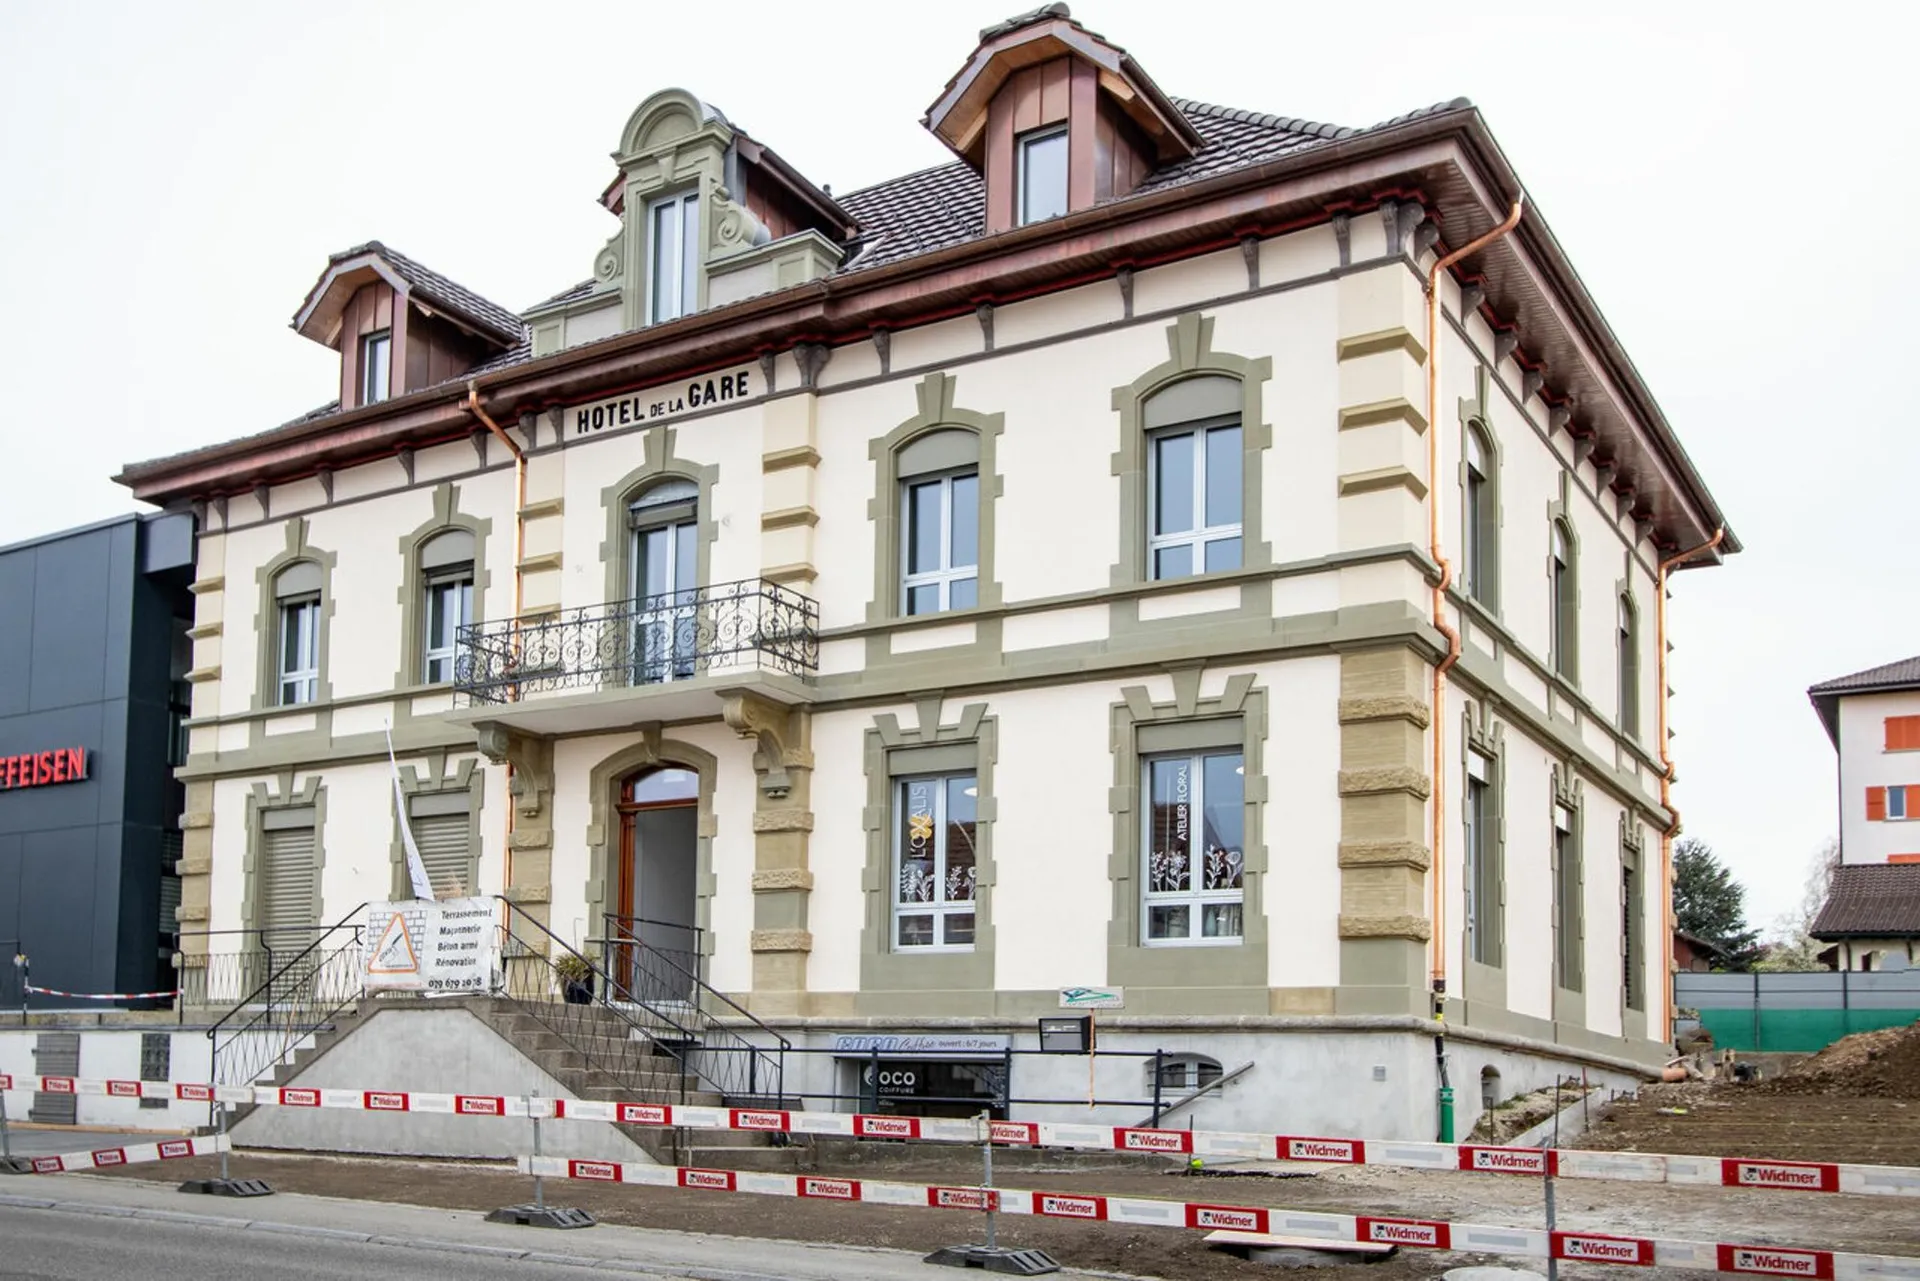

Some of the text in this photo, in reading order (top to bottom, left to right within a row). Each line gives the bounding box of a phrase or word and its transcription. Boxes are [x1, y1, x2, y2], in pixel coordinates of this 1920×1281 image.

[577, 371, 749, 434] HOTEL DE LA GARE
[1177, 765, 1187, 841] ATELIER FLORAL
[909, 785, 932, 857] L'OXALIS
[442, 909, 492, 920] Terrassement
[874, 1121, 907, 1133] Widmer
[1138, 1134, 1178, 1148] Widmer
[1304, 1143, 1348, 1157] Widmer
[1490, 1154, 1539, 1169] Widmer
[1758, 1168, 1816, 1184] Widmer
[816, 1183, 848, 1195] Widmer
[1055, 1200, 1093, 1214] Widmer
[1211, 1213, 1253, 1227] Widmer
[1385, 1226, 1432, 1241] Widmer
[1581, 1241, 1633, 1258] Widmer
[1753, 1255, 1811, 1272] Widmer
